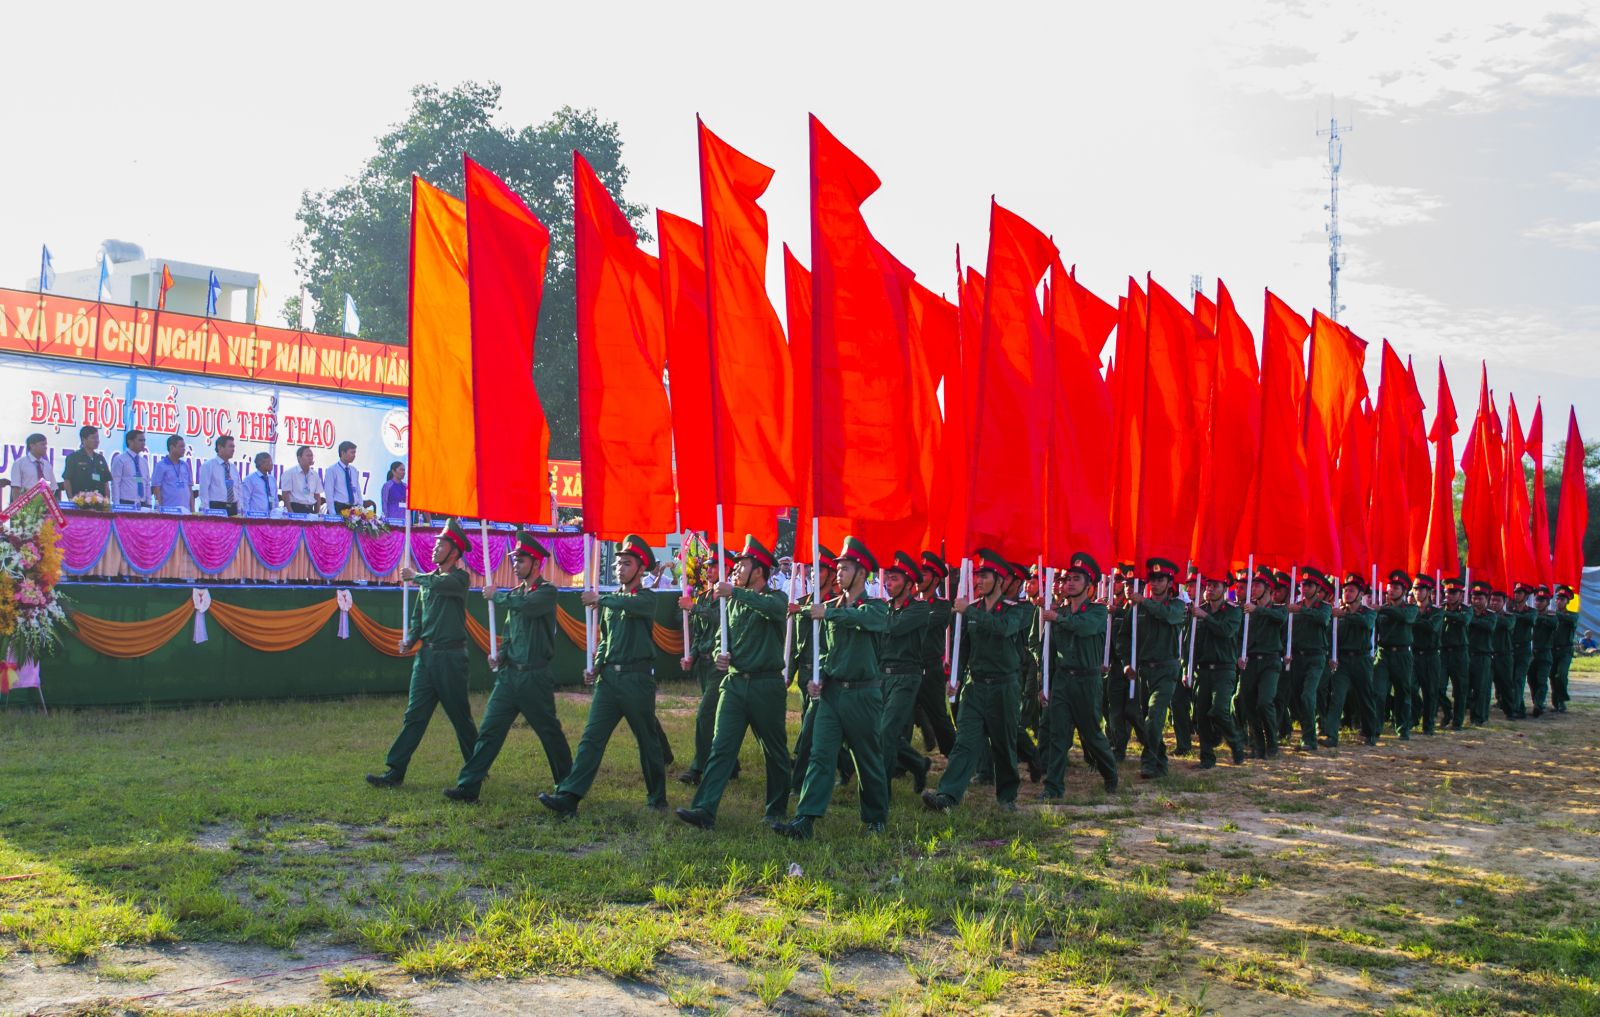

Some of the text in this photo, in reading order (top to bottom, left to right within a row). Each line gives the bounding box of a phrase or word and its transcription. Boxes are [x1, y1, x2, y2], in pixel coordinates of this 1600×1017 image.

[14, 300, 47, 342] XÃ
[55, 307, 97, 356] HỘI
[103, 312, 151, 355] CHỦ
[156, 323, 221, 364] NGHĨA
[227, 332, 271, 377] VIỆT
[275, 342, 317, 375] NAM
[320, 346, 371, 382] MUÔN
[31, 385, 335, 448] ĐẠI HỘI THỂ DỤC THỂ THAO
